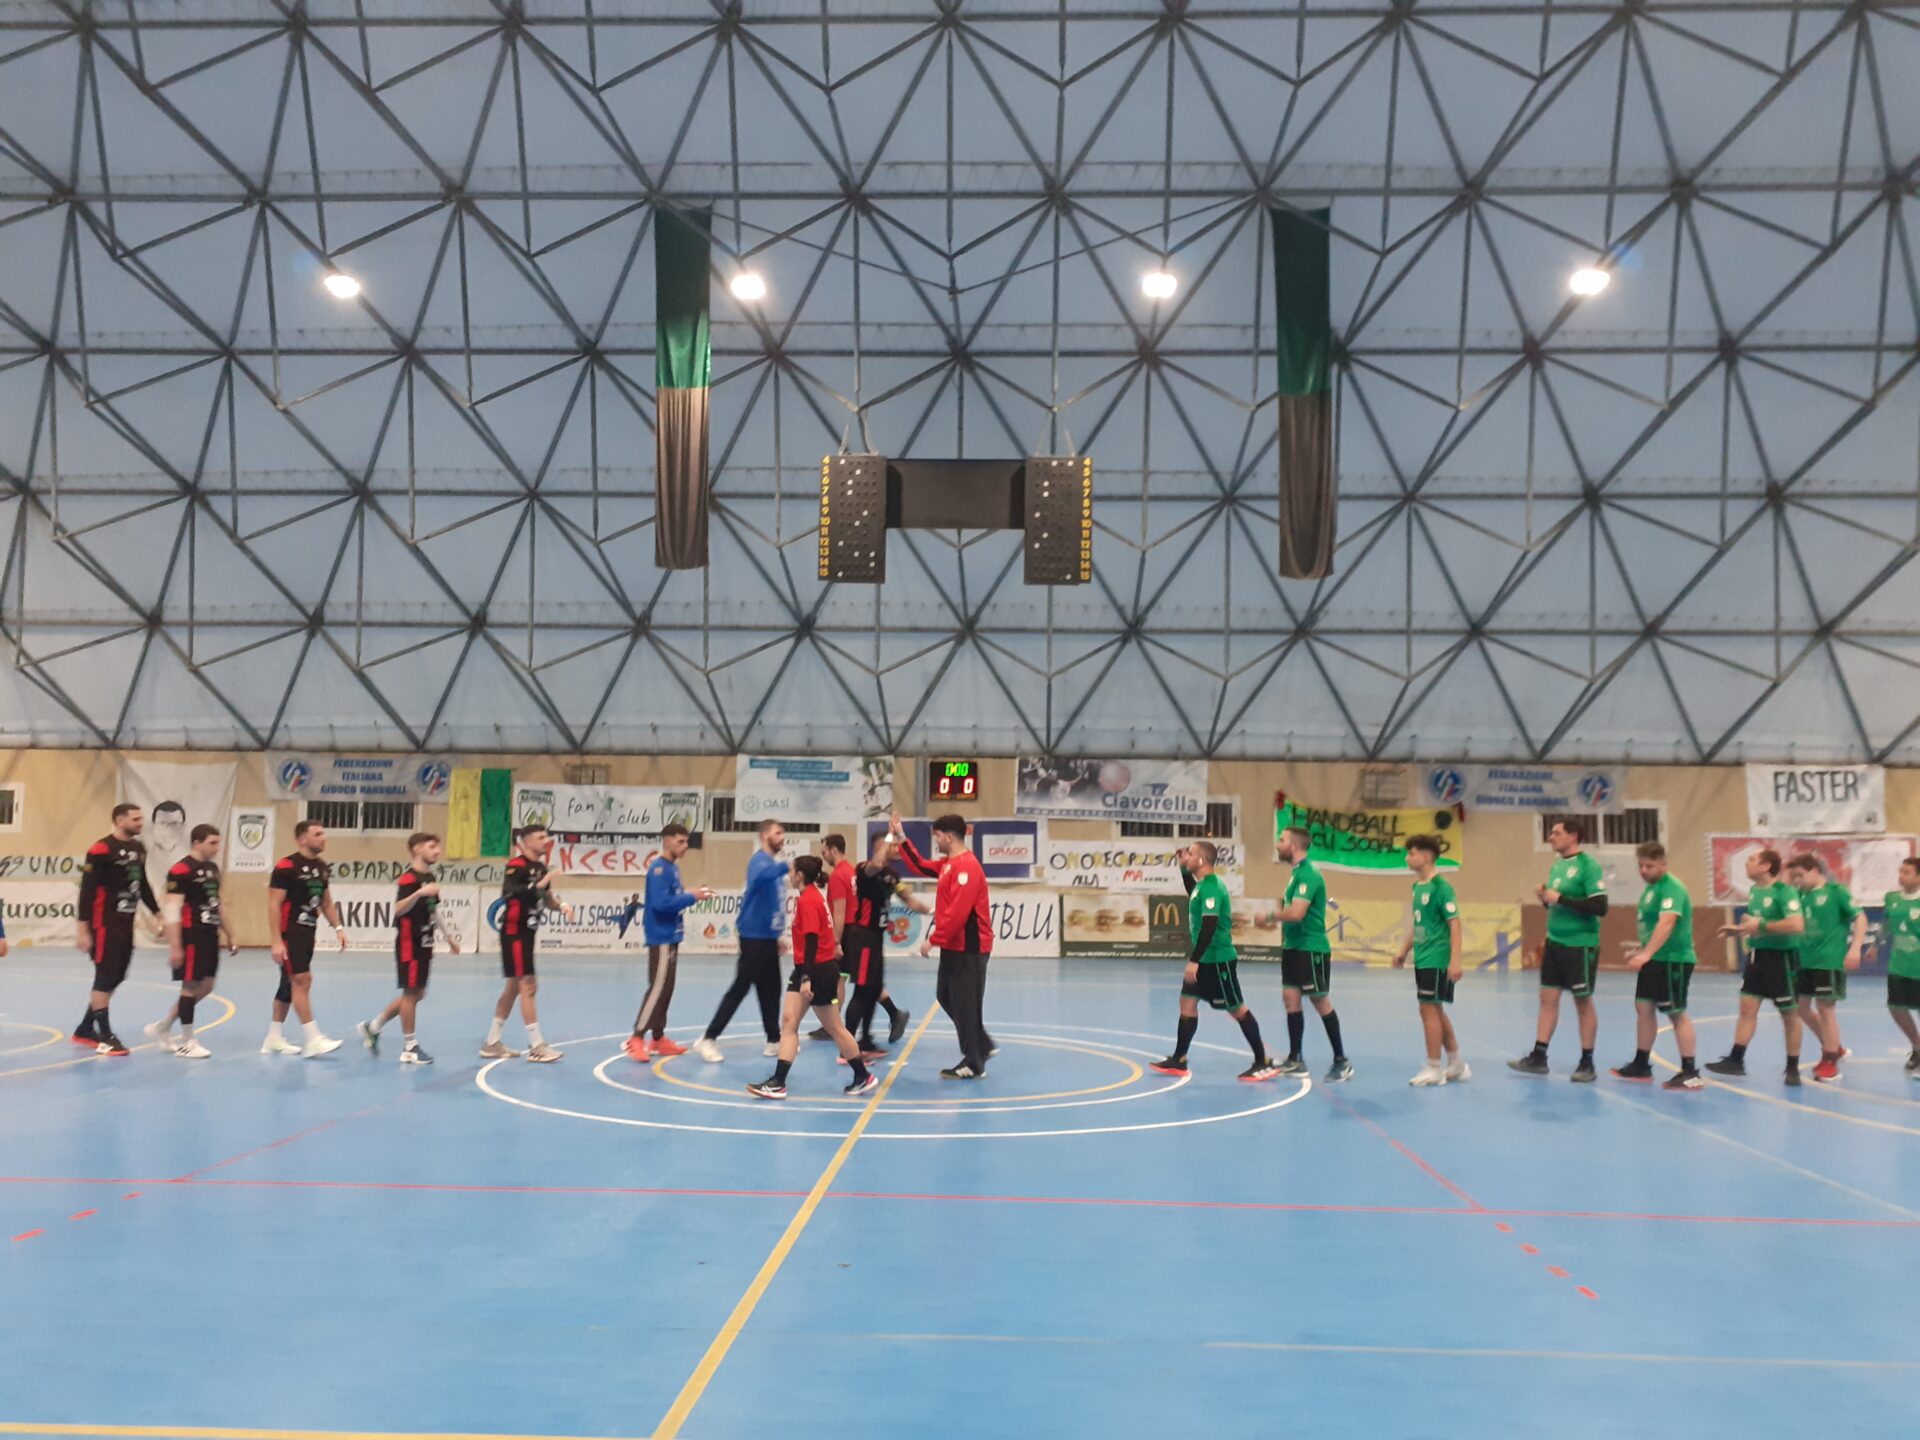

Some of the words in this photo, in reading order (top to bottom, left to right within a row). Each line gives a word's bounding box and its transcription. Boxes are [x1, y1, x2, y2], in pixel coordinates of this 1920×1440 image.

[821, 455, 831, 465] 4
[1082, 457, 1091, 467] 4
[821, 465, 831, 475] 5
[1082, 467, 1091, 477] 5
[821, 475, 831, 485] 6
[1082, 478, 1091, 488] 6
[821, 485, 831, 495] 7
[1082, 488, 1091, 498] 7
[821, 496, 831, 506] 8
[1082, 498, 1091, 508] 8
[821, 506, 831, 515] 9
[1082, 508, 1091, 518] 9
[940, 778, 950, 794] 0
[964, 778, 974, 794] 0
[1774, 770, 1859, 802] FASTER
[568, 797, 595, 816] fan
[618, 808, 650, 825] club
[1291, 805, 1405, 836] HANDBALL
